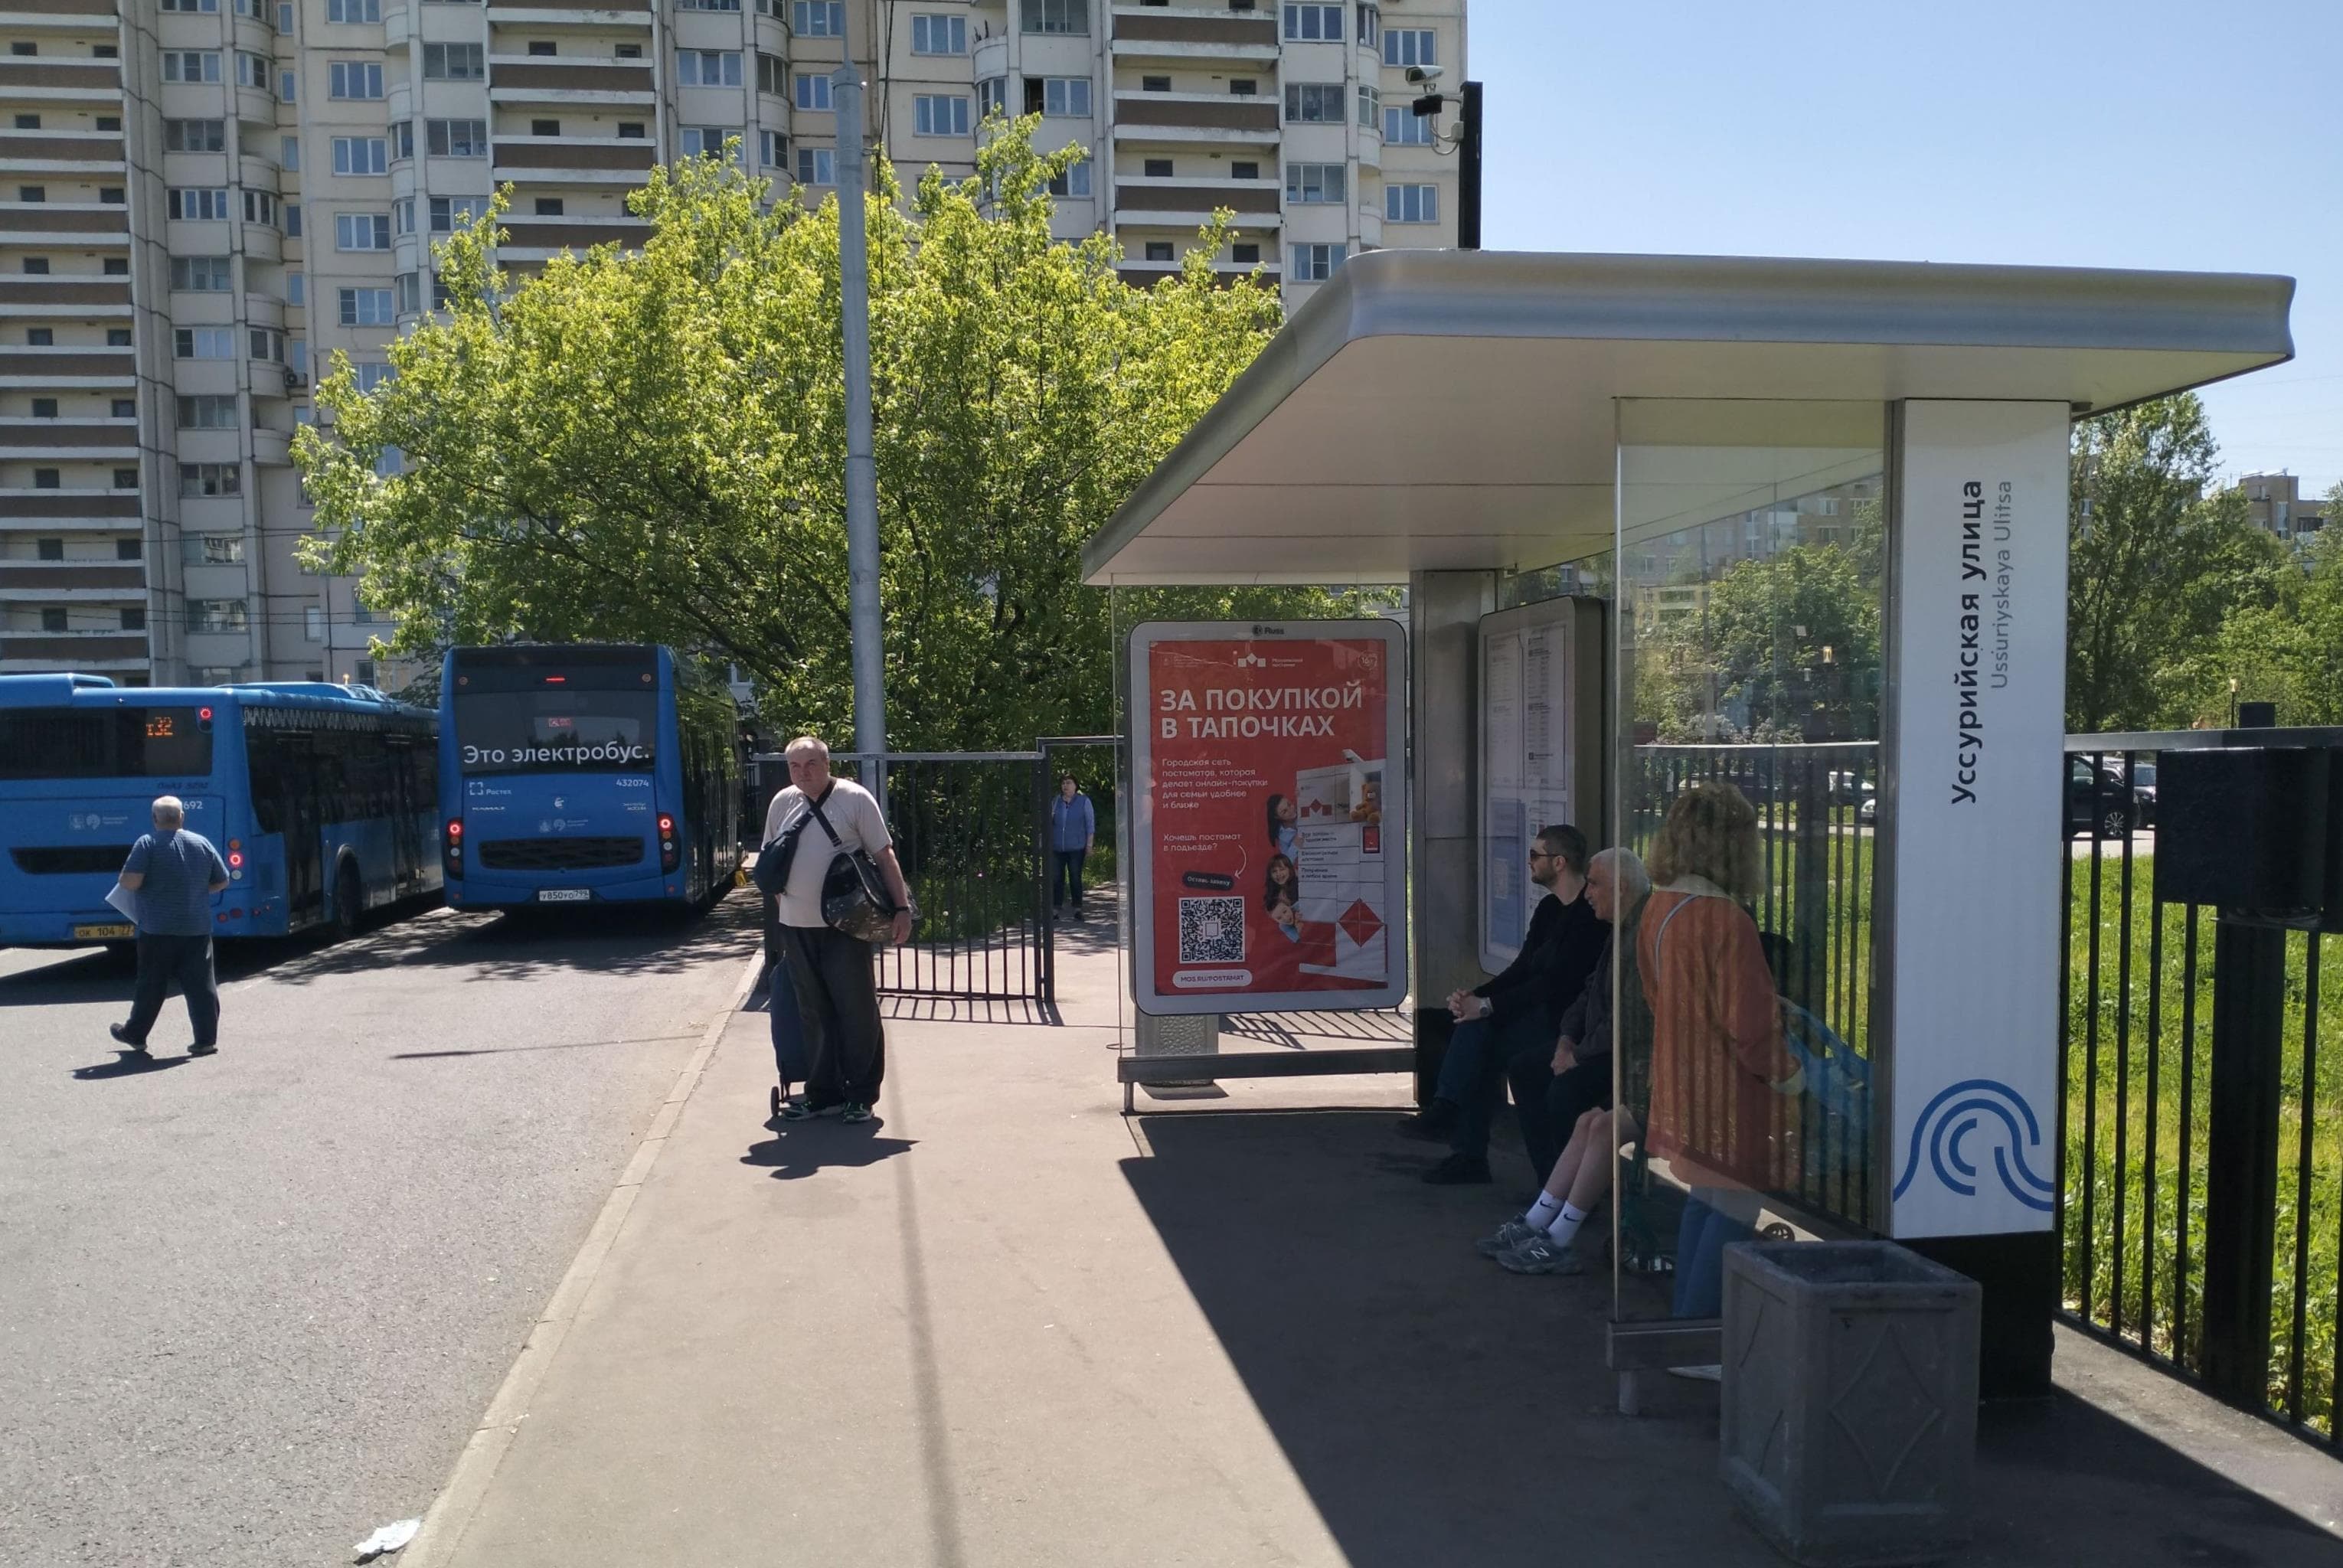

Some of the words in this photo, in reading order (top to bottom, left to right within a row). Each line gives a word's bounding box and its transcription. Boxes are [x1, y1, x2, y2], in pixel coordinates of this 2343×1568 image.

[1993, 481, 2011, 541] Ulitsa
[1961, 481, 1985, 580] улица
[1991, 549, 2014, 689] Ussuriyskaya
[1160, 688, 1197, 711] ЗА
[1206, 679, 1361, 710] ПОКУПКОЙ
[1951, 593, 1982, 804] Уссурийская
[1161, 717, 1178, 739] В
[1187, 715, 1335, 739] ТАПОЧКАХ
[463, 745, 505, 763] Это
[511, 740, 649, 764] электробус.
[1162, 759, 1209, 767] Городская
[616, 779, 649, 787] 432074
[1211, 789, 1247, 799] удобнее
[1163, 833, 1196, 841] Хочешь
